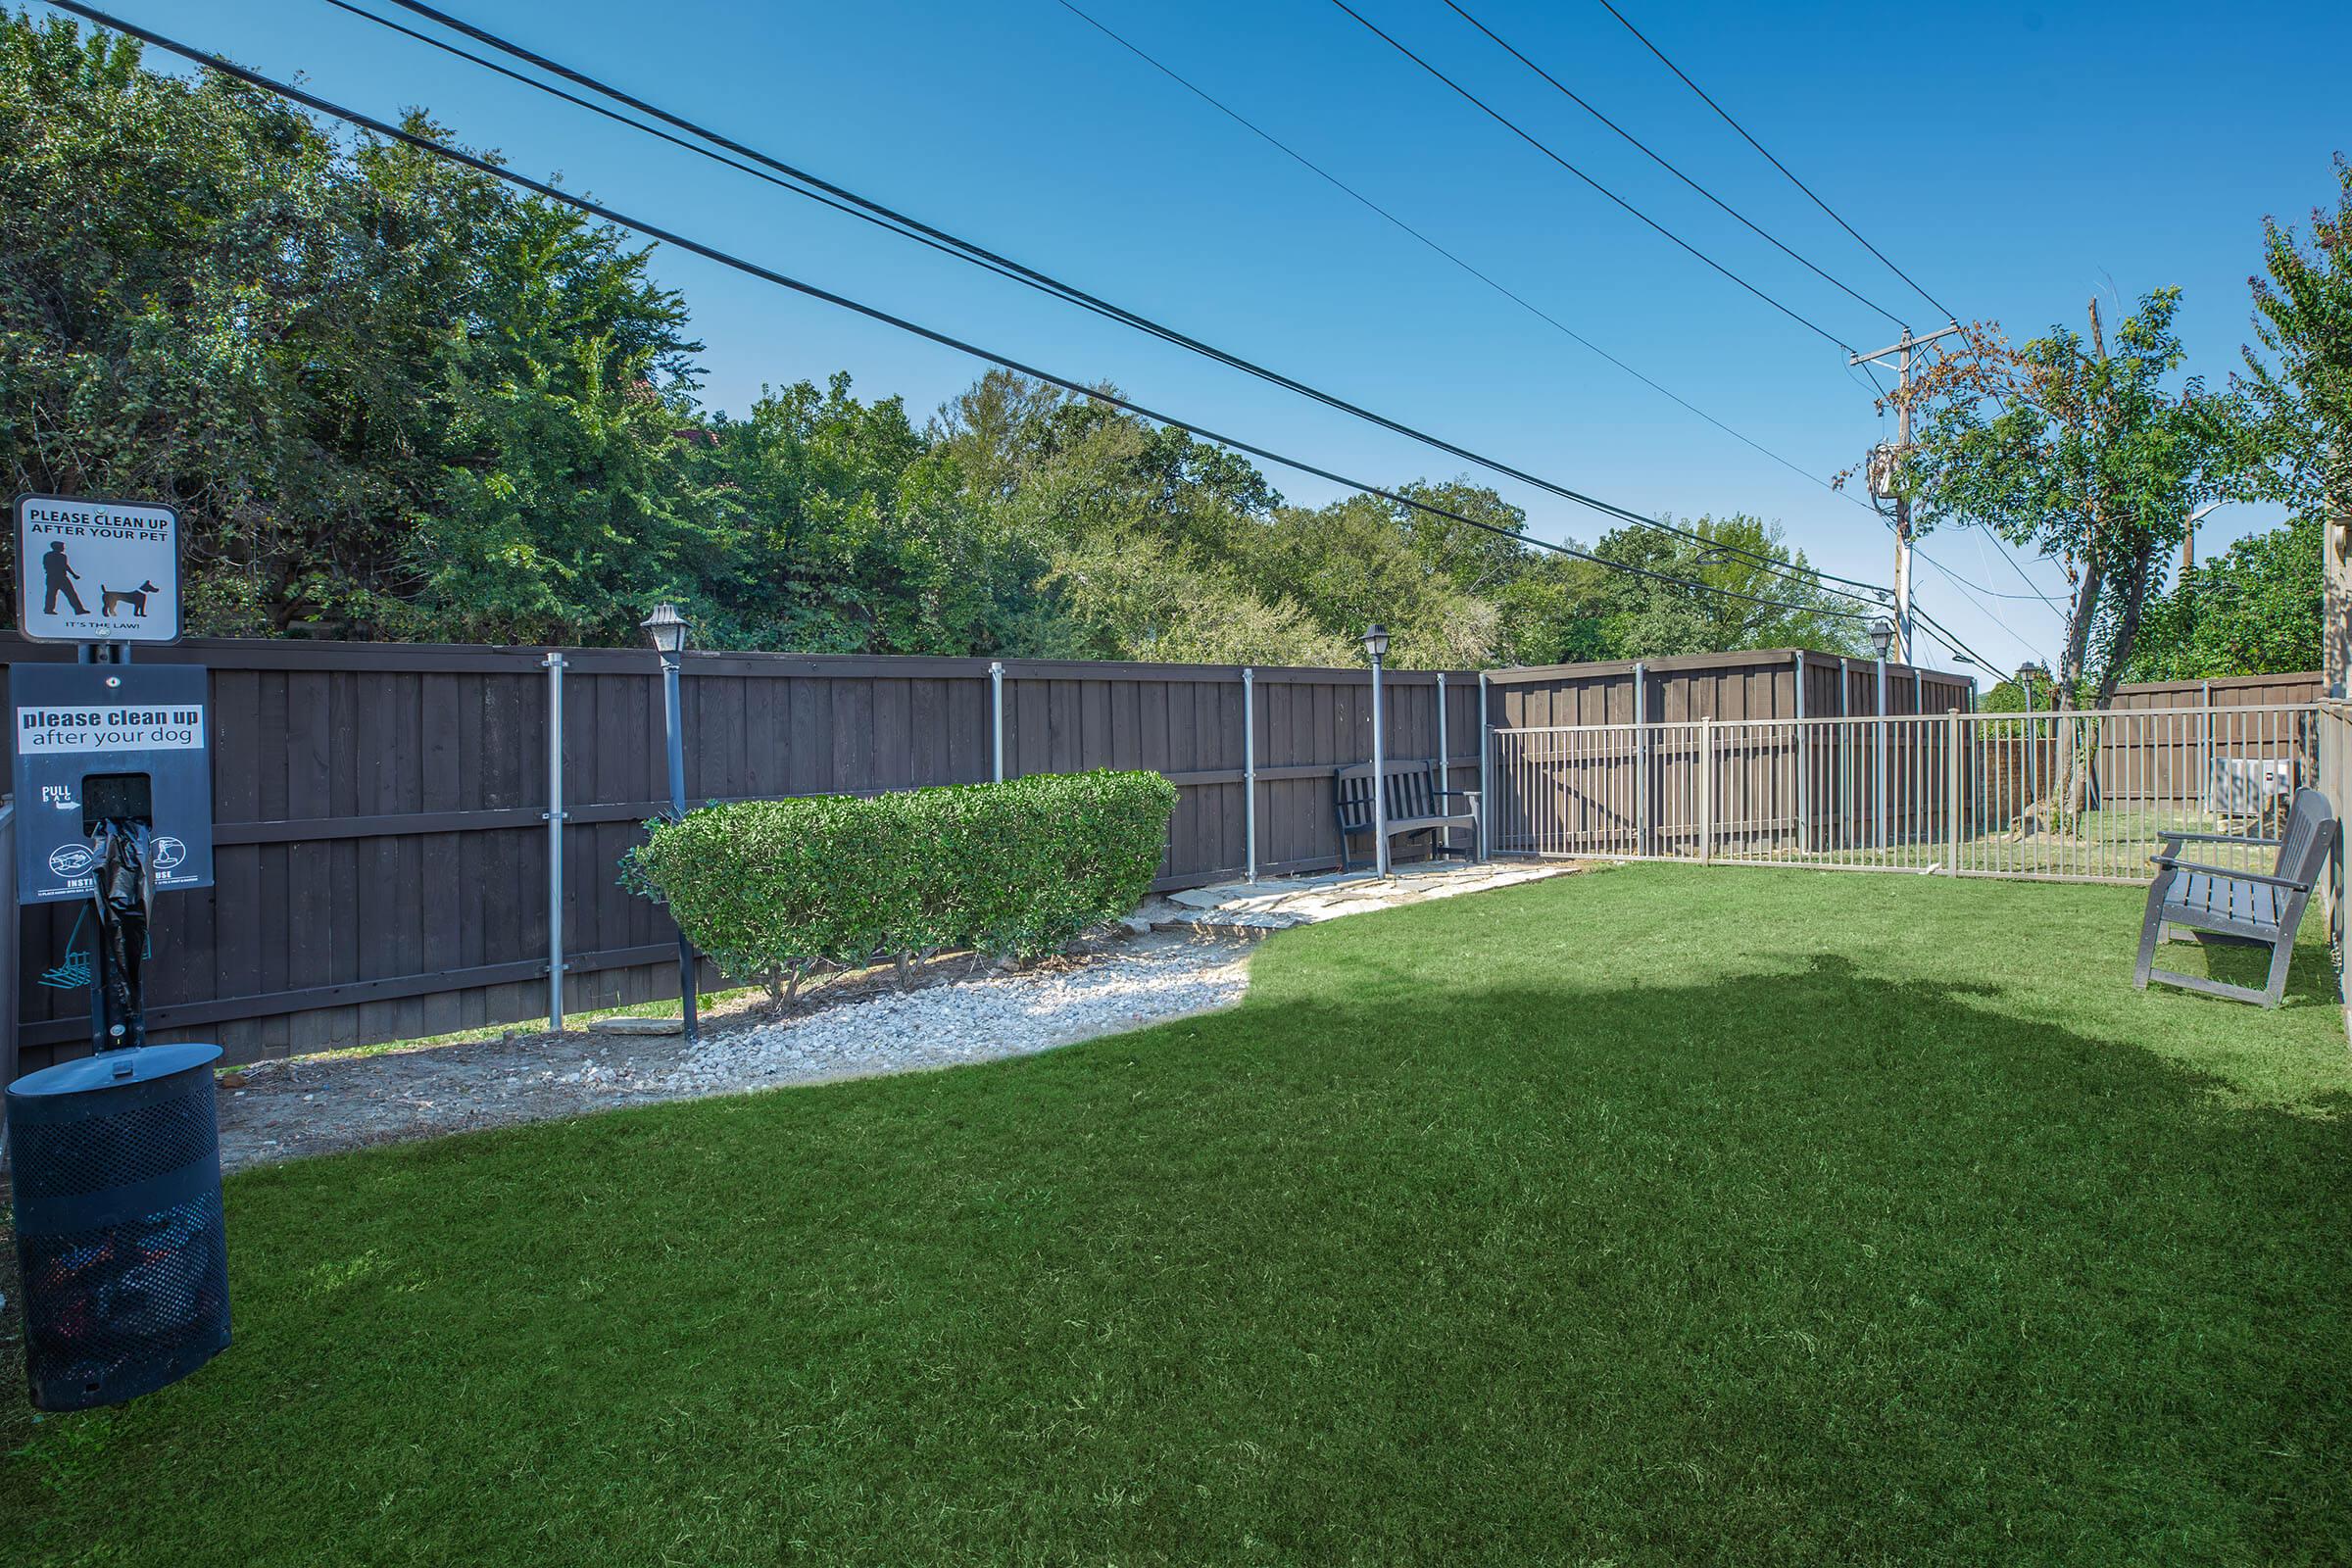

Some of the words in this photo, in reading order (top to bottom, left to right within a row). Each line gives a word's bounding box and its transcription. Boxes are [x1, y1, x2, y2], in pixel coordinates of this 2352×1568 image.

[30, 510, 90, 524] PLEASE
[94, 514, 143, 528] CLEAN
[148, 518, 168, 530] UP
[31, 524, 85, 536] AFTER
[89, 528, 134, 539] YOUR
[139, 532, 168, 542] PET
[23, 710, 102, 729] please
[108, 710, 168, 726] clean
[173, 710, 198, 725] up
[32, 729, 87, 745] after
[94, 730, 144, 748] your
[150, 727, 192, 745] dog
[42, 785, 72, 796] PULL
